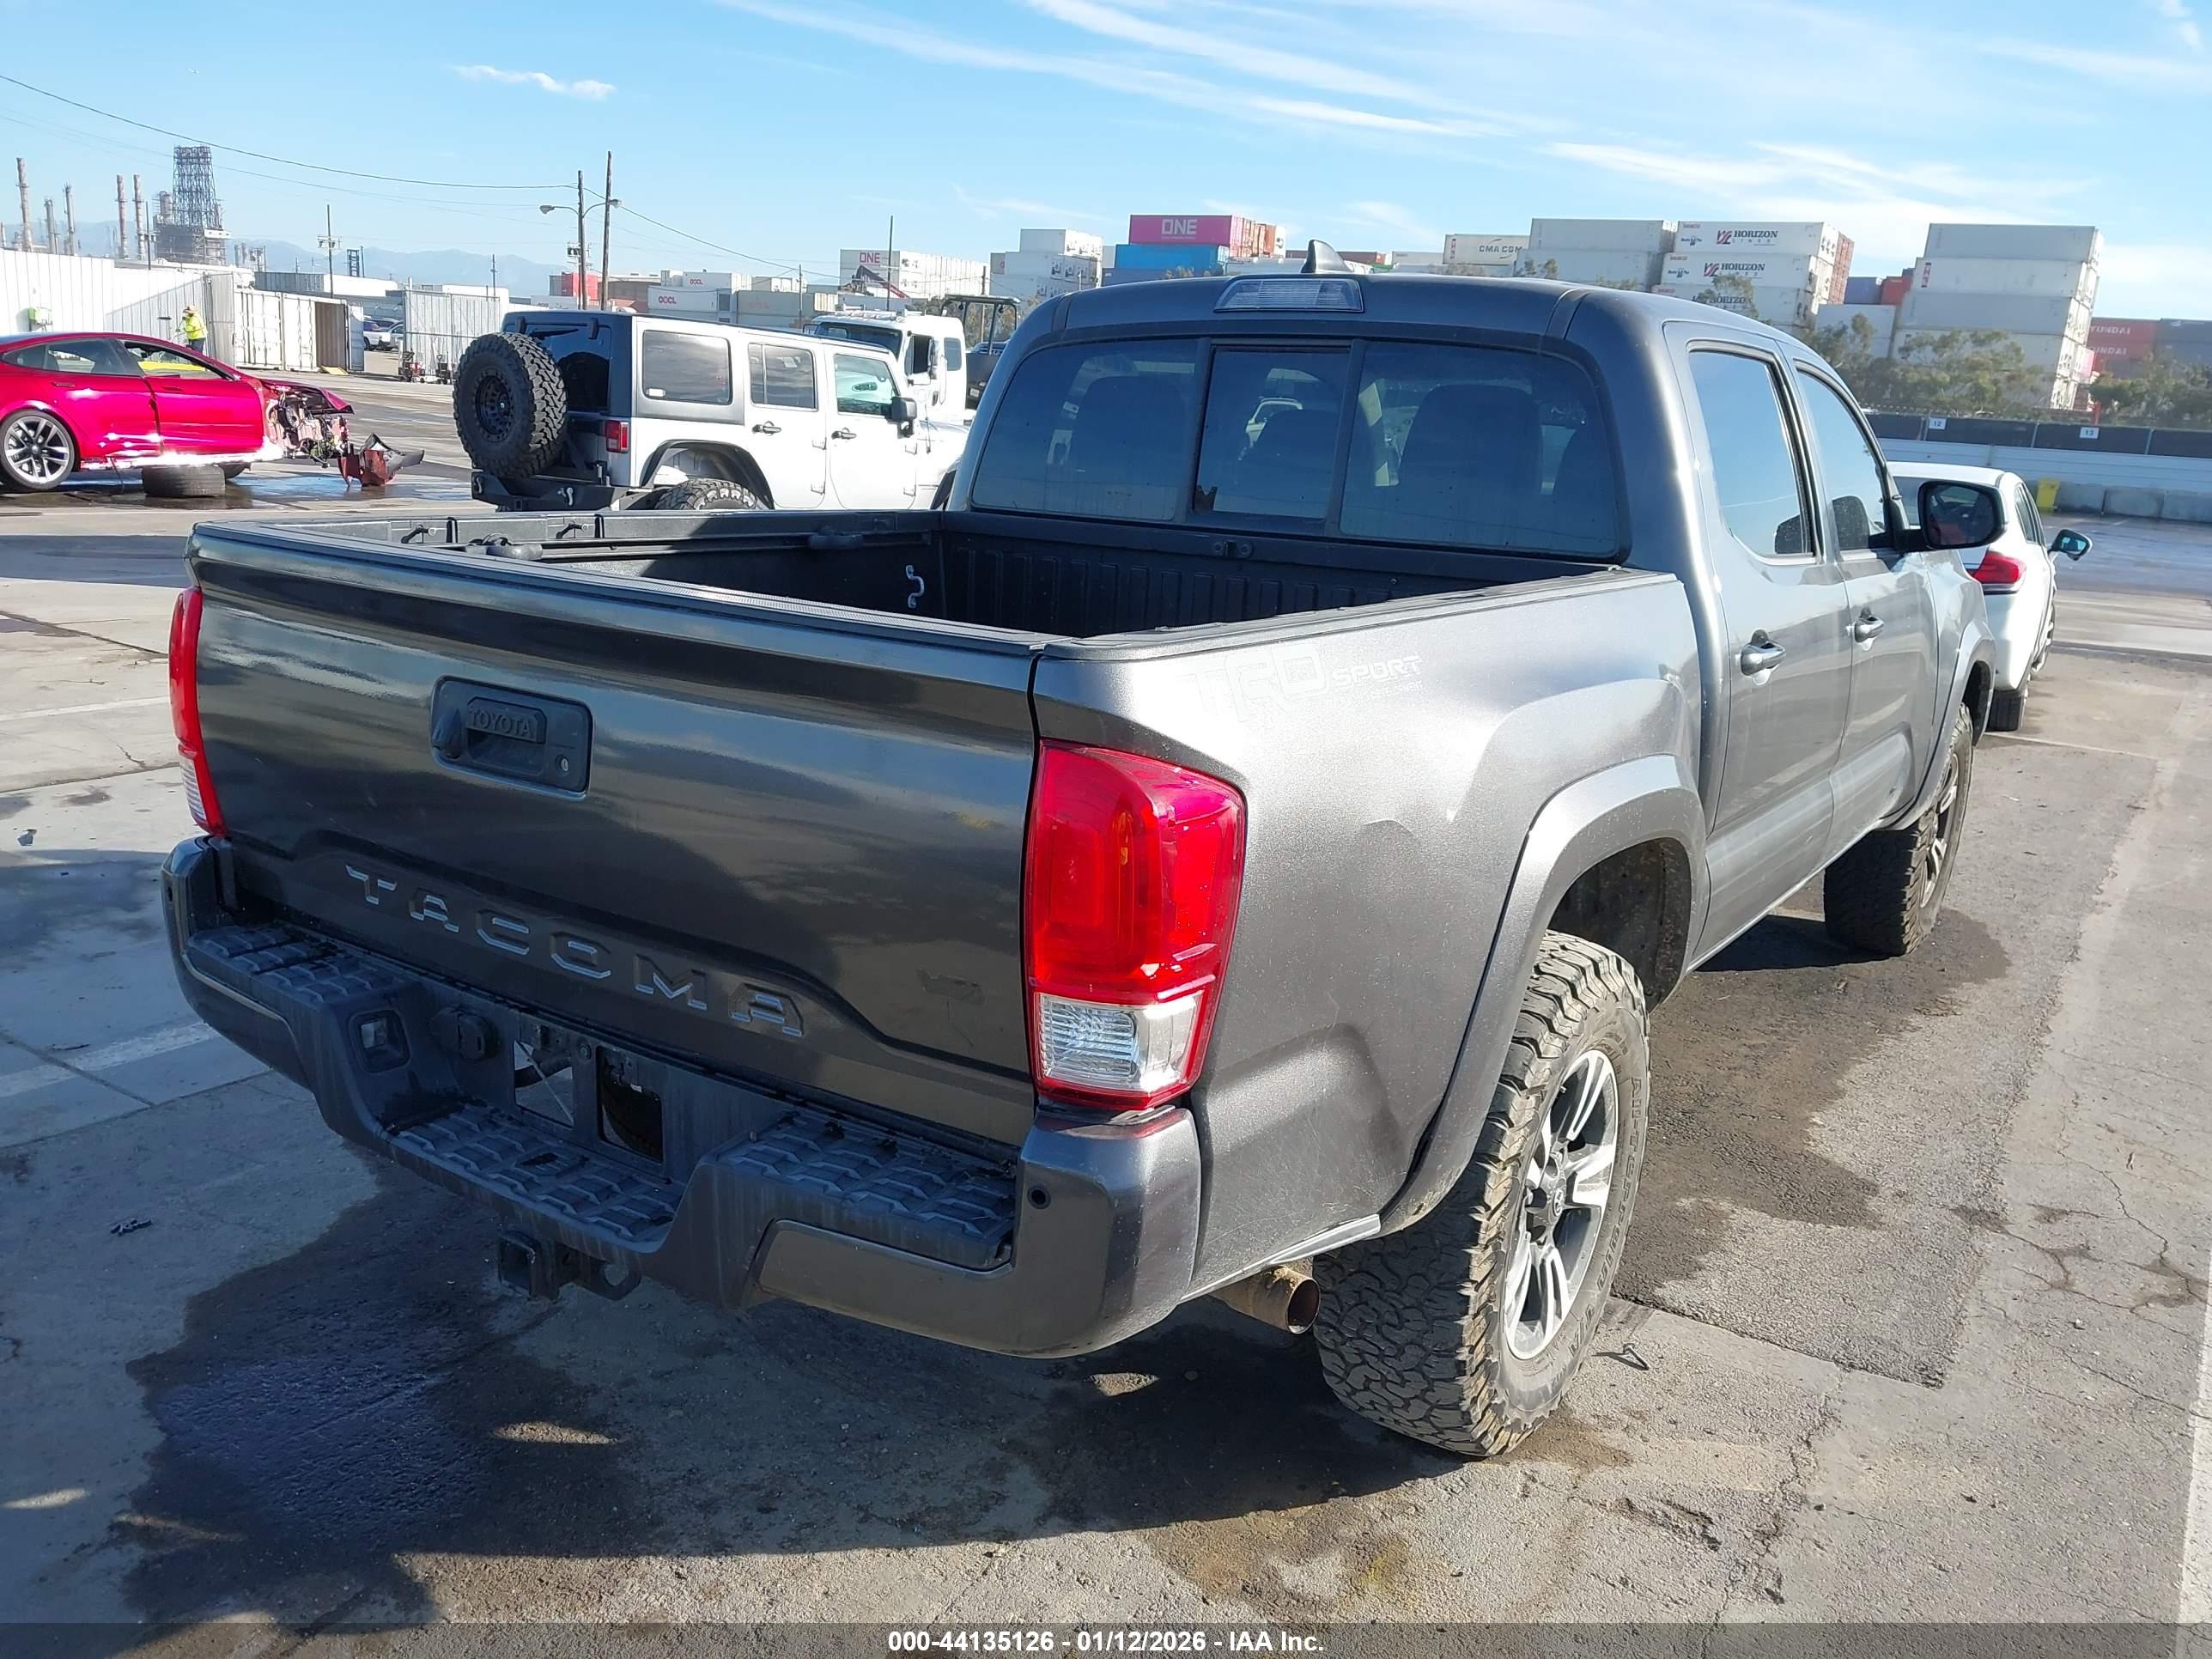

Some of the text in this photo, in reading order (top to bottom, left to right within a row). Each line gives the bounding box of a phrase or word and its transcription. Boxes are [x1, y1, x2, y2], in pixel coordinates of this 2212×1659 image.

[1161, 219, 1197, 234] ONE
[860, 252, 880, 263] ONE
[659, 295, 678, 304] OOCL
[1709, 295, 1748, 304] ORIZO
[2090, 325, 2130, 335] YUNDAI
[2093, 346, 2127, 356] UNDAI
[1332, 655, 1423, 690] SPORT
[469, 708, 532, 738] TOYOTA
[345, 864, 805, 1038] TACOMA
